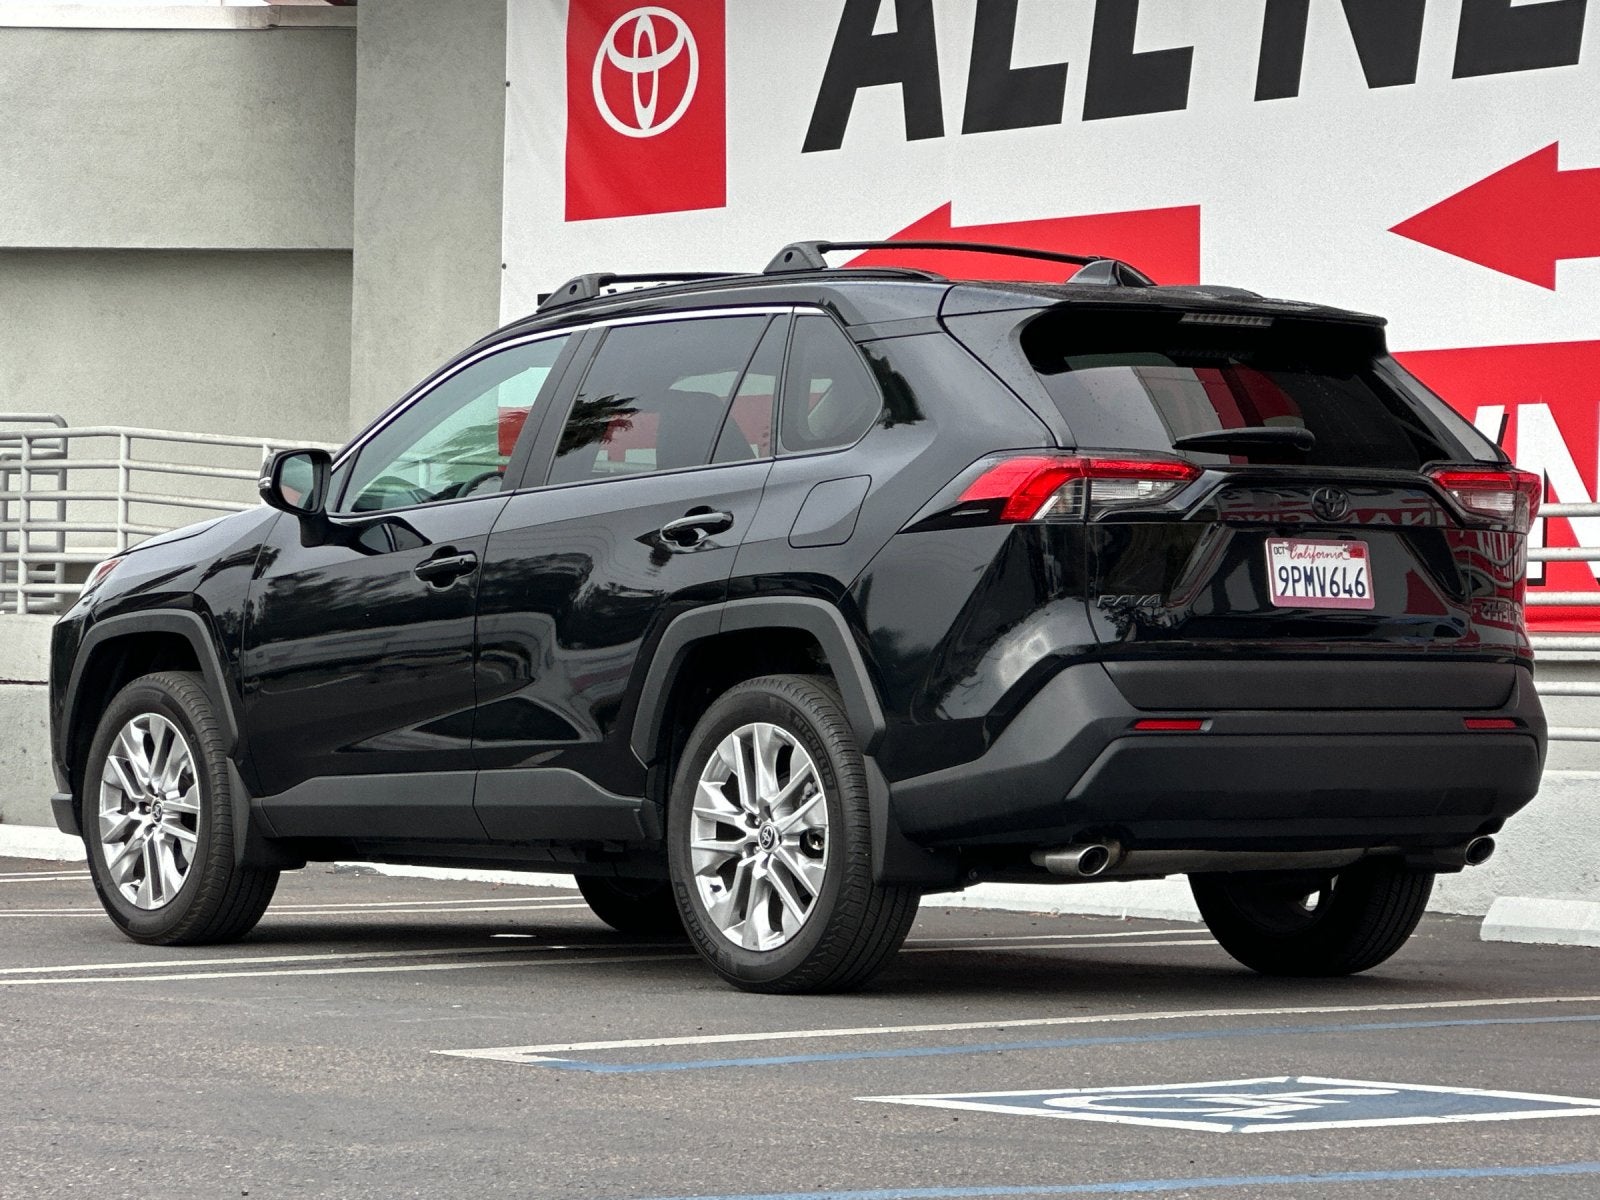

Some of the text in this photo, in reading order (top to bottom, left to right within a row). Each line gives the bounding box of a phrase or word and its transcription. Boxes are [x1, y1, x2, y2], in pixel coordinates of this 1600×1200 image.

[1289, 546, 1350, 564] California
[1278, 565, 1366, 598] 9PMV646
[1096, 593, 1162, 608] RAV4
[793, 715, 834, 787] MICHELIN
[676, 886, 718, 955] MICHELIN
